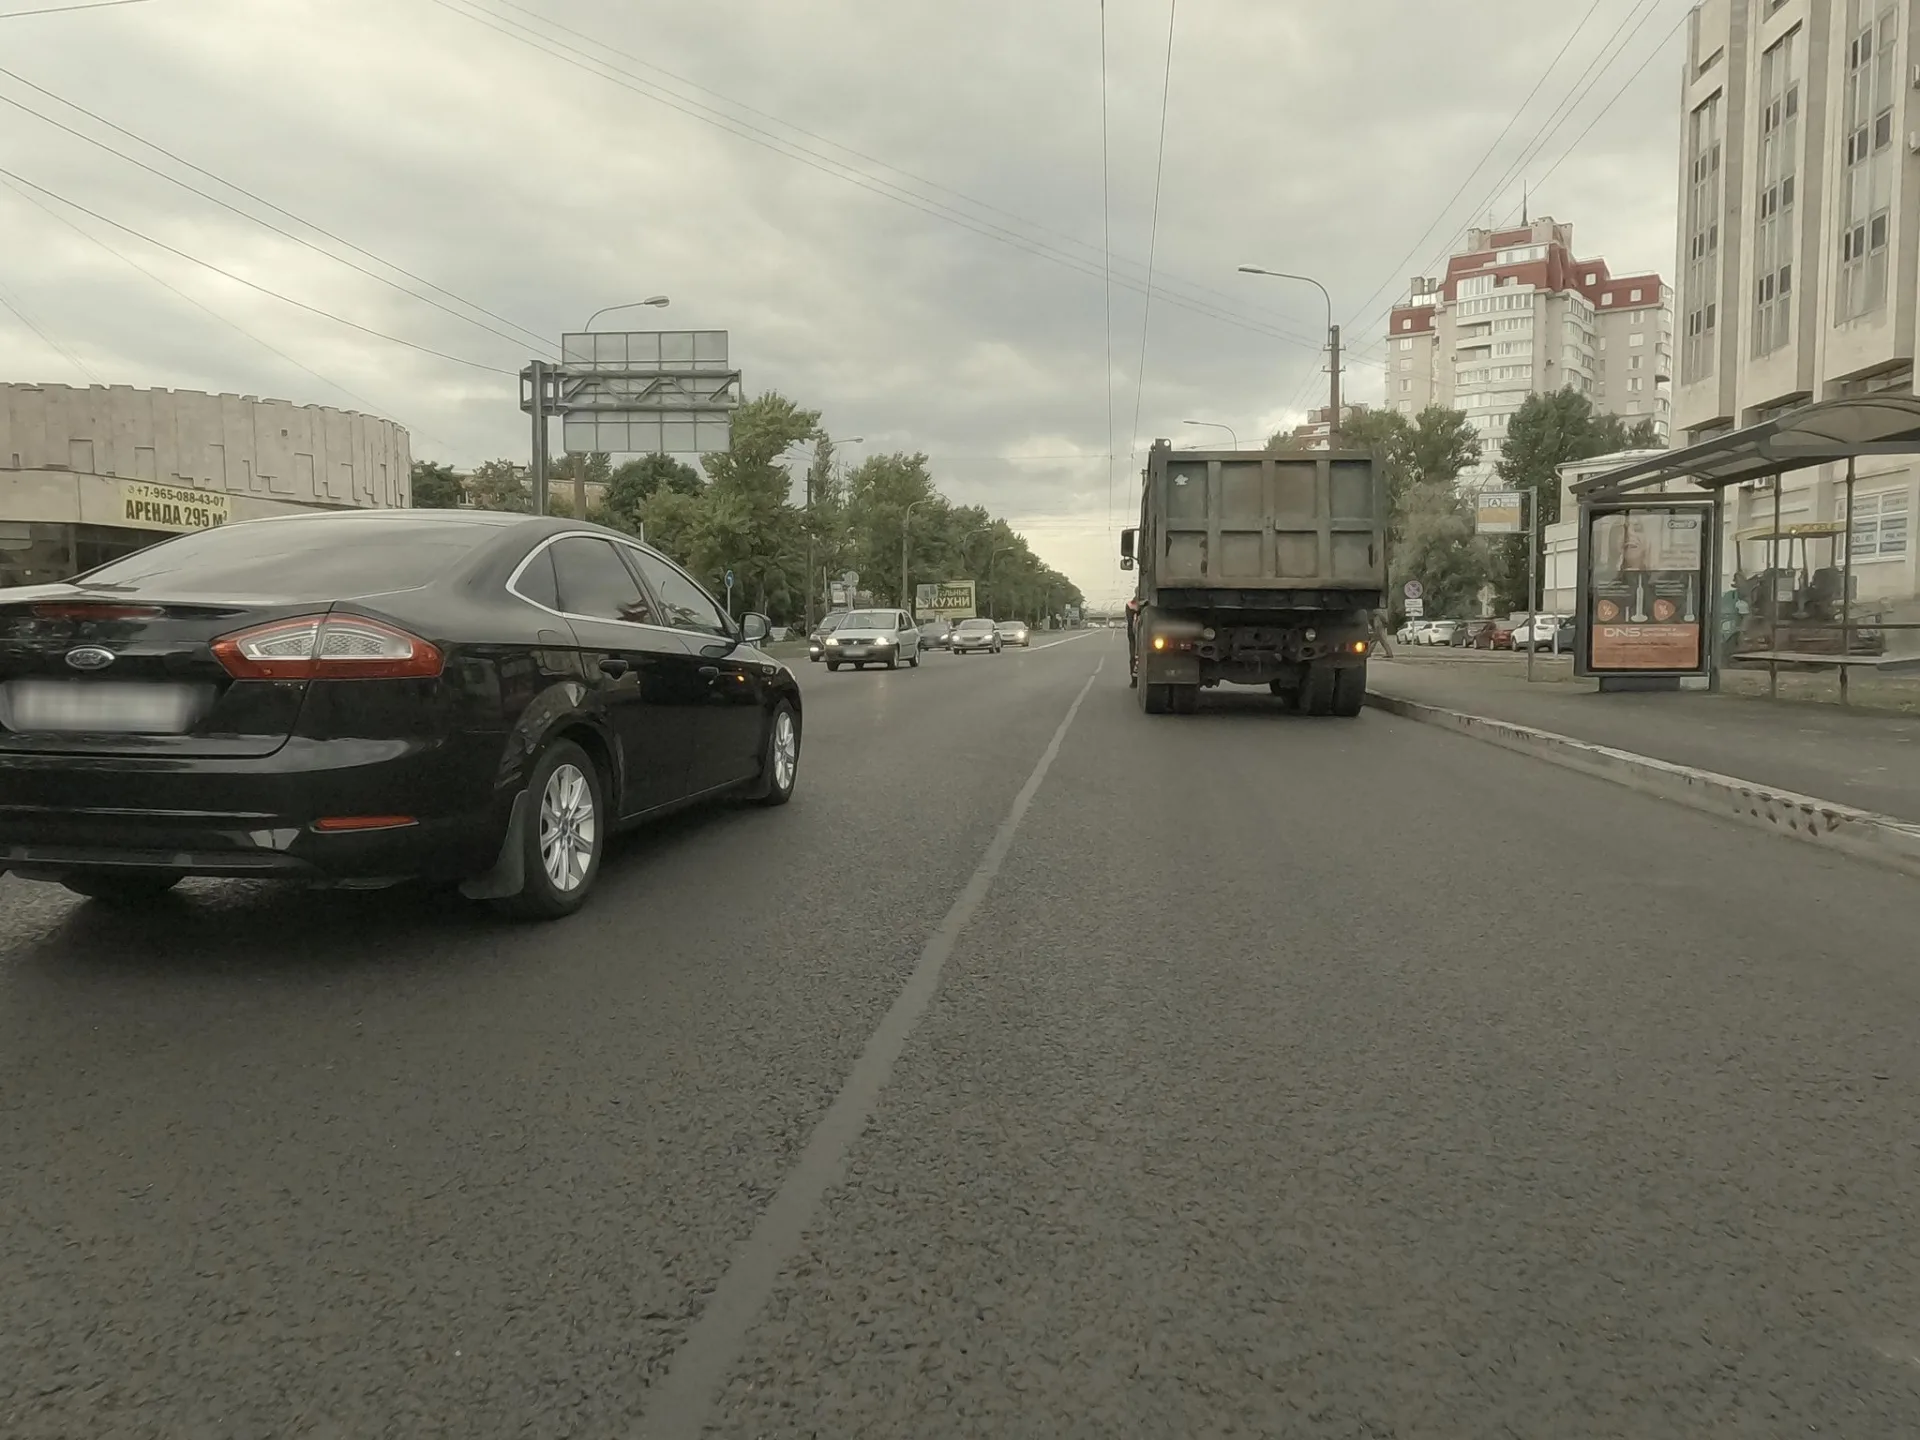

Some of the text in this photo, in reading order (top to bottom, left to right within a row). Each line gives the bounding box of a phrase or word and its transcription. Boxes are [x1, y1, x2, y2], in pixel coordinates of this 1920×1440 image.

[137, 486, 224, 507] +7-965-088-43-07
[126, 500, 182, 525] АРЕНДА
[184, 506, 210, 528] 295
[931, 596, 970, 607] КУХНИ
[1603, 627, 1642, 638] DNS
